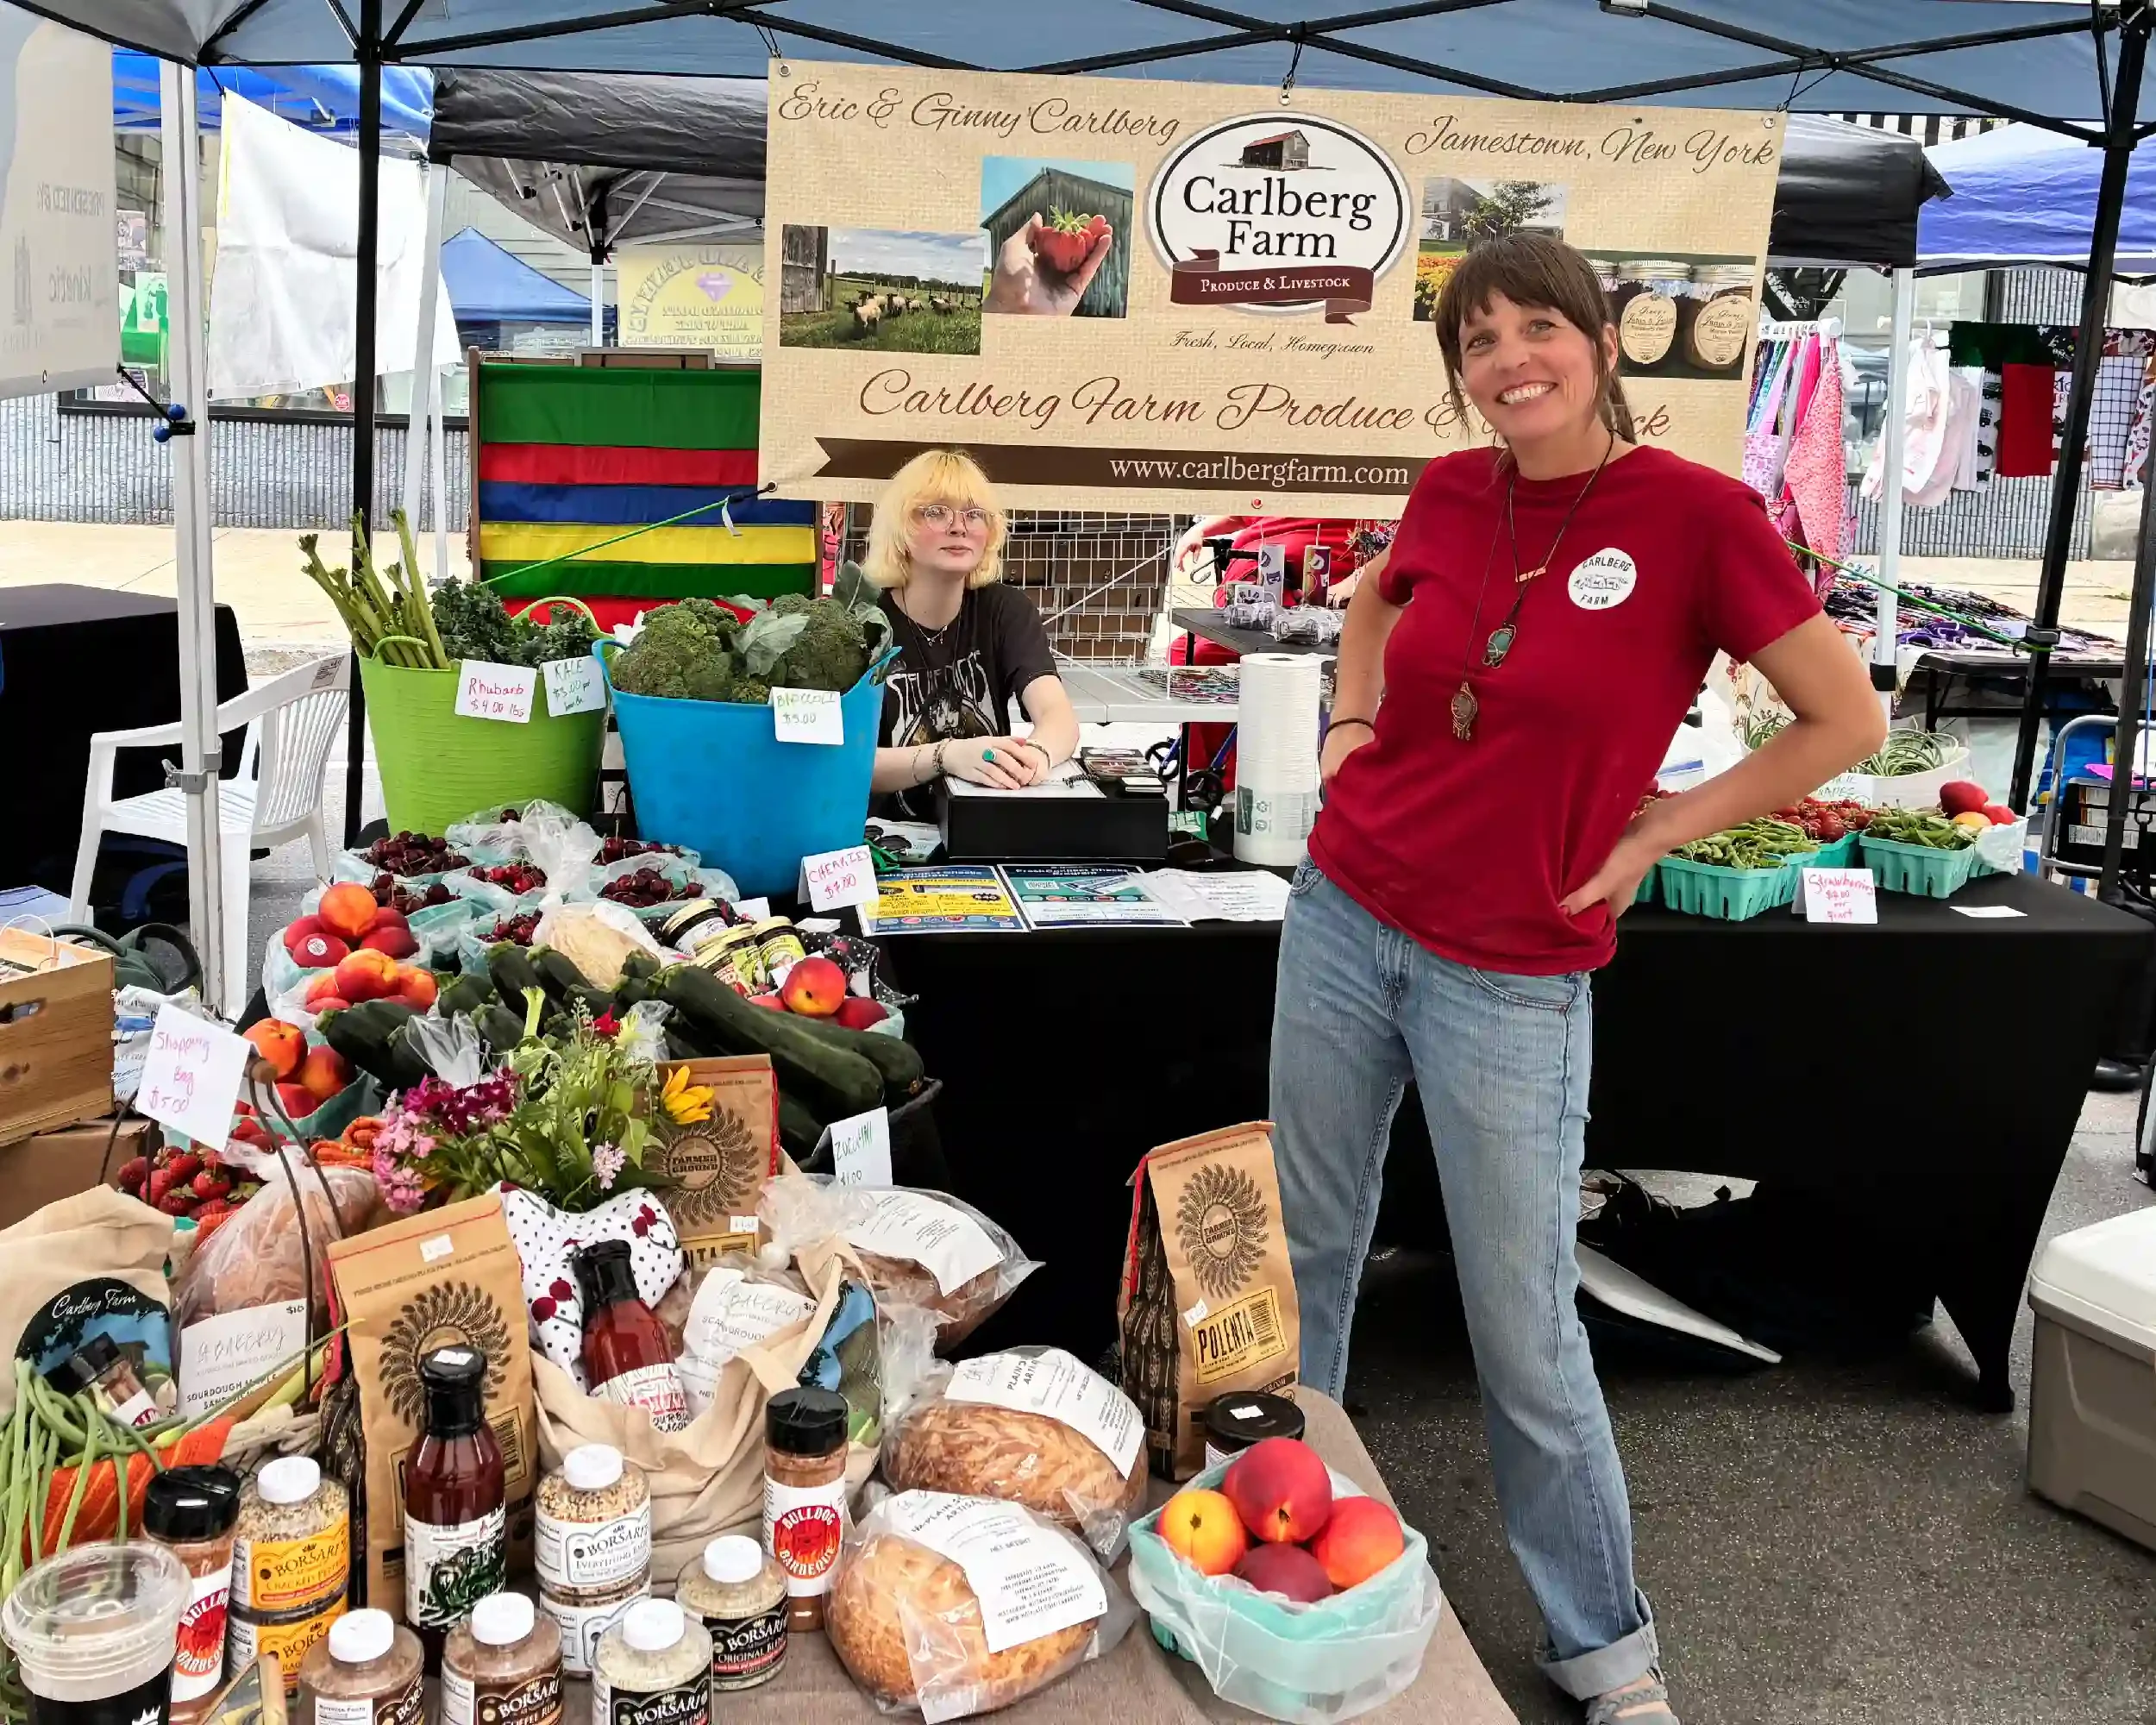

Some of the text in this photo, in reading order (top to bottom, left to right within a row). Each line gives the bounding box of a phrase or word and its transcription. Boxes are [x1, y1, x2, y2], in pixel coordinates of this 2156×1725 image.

[778, 78, 1181, 146] Eric & Ginny Carlberg
[1405, 115, 1775, 173] Jamestown, New York
[1183, 176, 1377, 230] Carlberg
[1225, 220, 1338, 258] Farm
[1263, 277, 1275, 290] &
[1169, 329, 1376, 360] Fresh, Local, Homegrown
[860, 368, 1062, 430] Carlberg
[1071, 376, 1206, 425] Farm
[1217, 382, 1415, 430] Produce
[1109, 455, 1410, 488] www.carlbergfarm.com
[1583, 556, 1632, 571] CARLBERG
[1580, 595, 1608, 605] FARM
[469, 677, 523, 695] Rhubarb
[1808, 872, 1874, 895] Strawberries
[1203, 1218, 1233, 1236] FARMER
[1206, 1229, 1236, 1245] GROUND
[53, 1289, 137, 1319] Carlberg Farm
[1198, 1308, 1256, 1364] POLENTA
[186, 1381, 242, 1403] SOURDOUGH
[782, 1507, 835, 1530] BULLDOG
[780, 1543, 836, 1577] BARBEQUE
[718, 1647, 765, 1663] ORIGINAL
